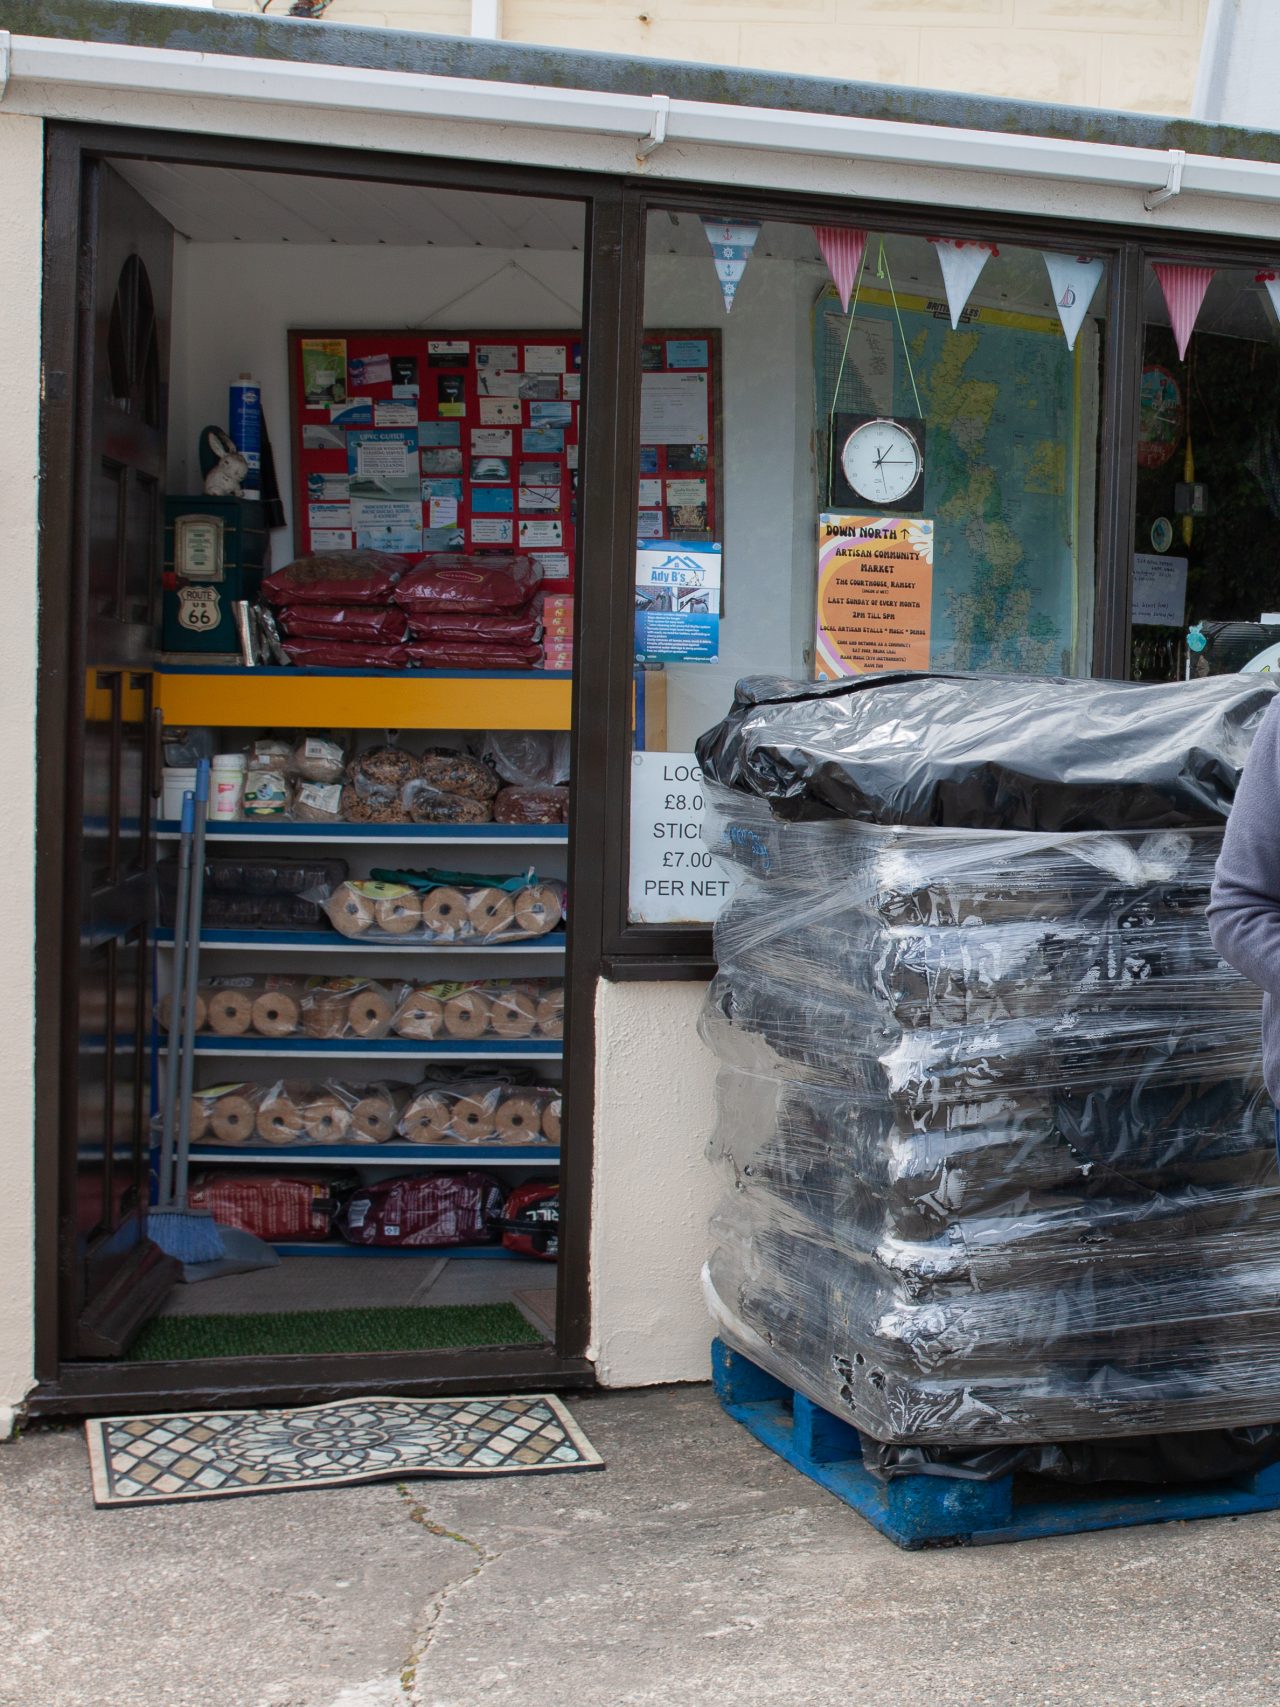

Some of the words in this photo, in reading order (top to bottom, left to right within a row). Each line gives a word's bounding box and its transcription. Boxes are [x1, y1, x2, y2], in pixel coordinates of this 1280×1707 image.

[826, 525, 856, 538] DOWN
[859, 527, 897, 540] NORTH
[860, 563, 895, 574] MARKET
[651, 570, 670, 583] Ady
[671, 571, 686, 583] B's
[836, 578, 848, 586] THE
[890, 581, 916, 589] RAMSEY
[186, 590, 213, 600] ROUTE
[827, 597, 844, 605] LAST
[846, 598, 870, 606] SUNDAY
[879, 599, 898, 607] EVERY
[899, 600, 921, 608] MONTH
[188, 608, 211, 624] 66
[664, 793, 706, 811] £8.0
[662, 852, 713, 868] £7.00
[644, 880, 685, 896] PER
[690, 880, 731, 897] NET
